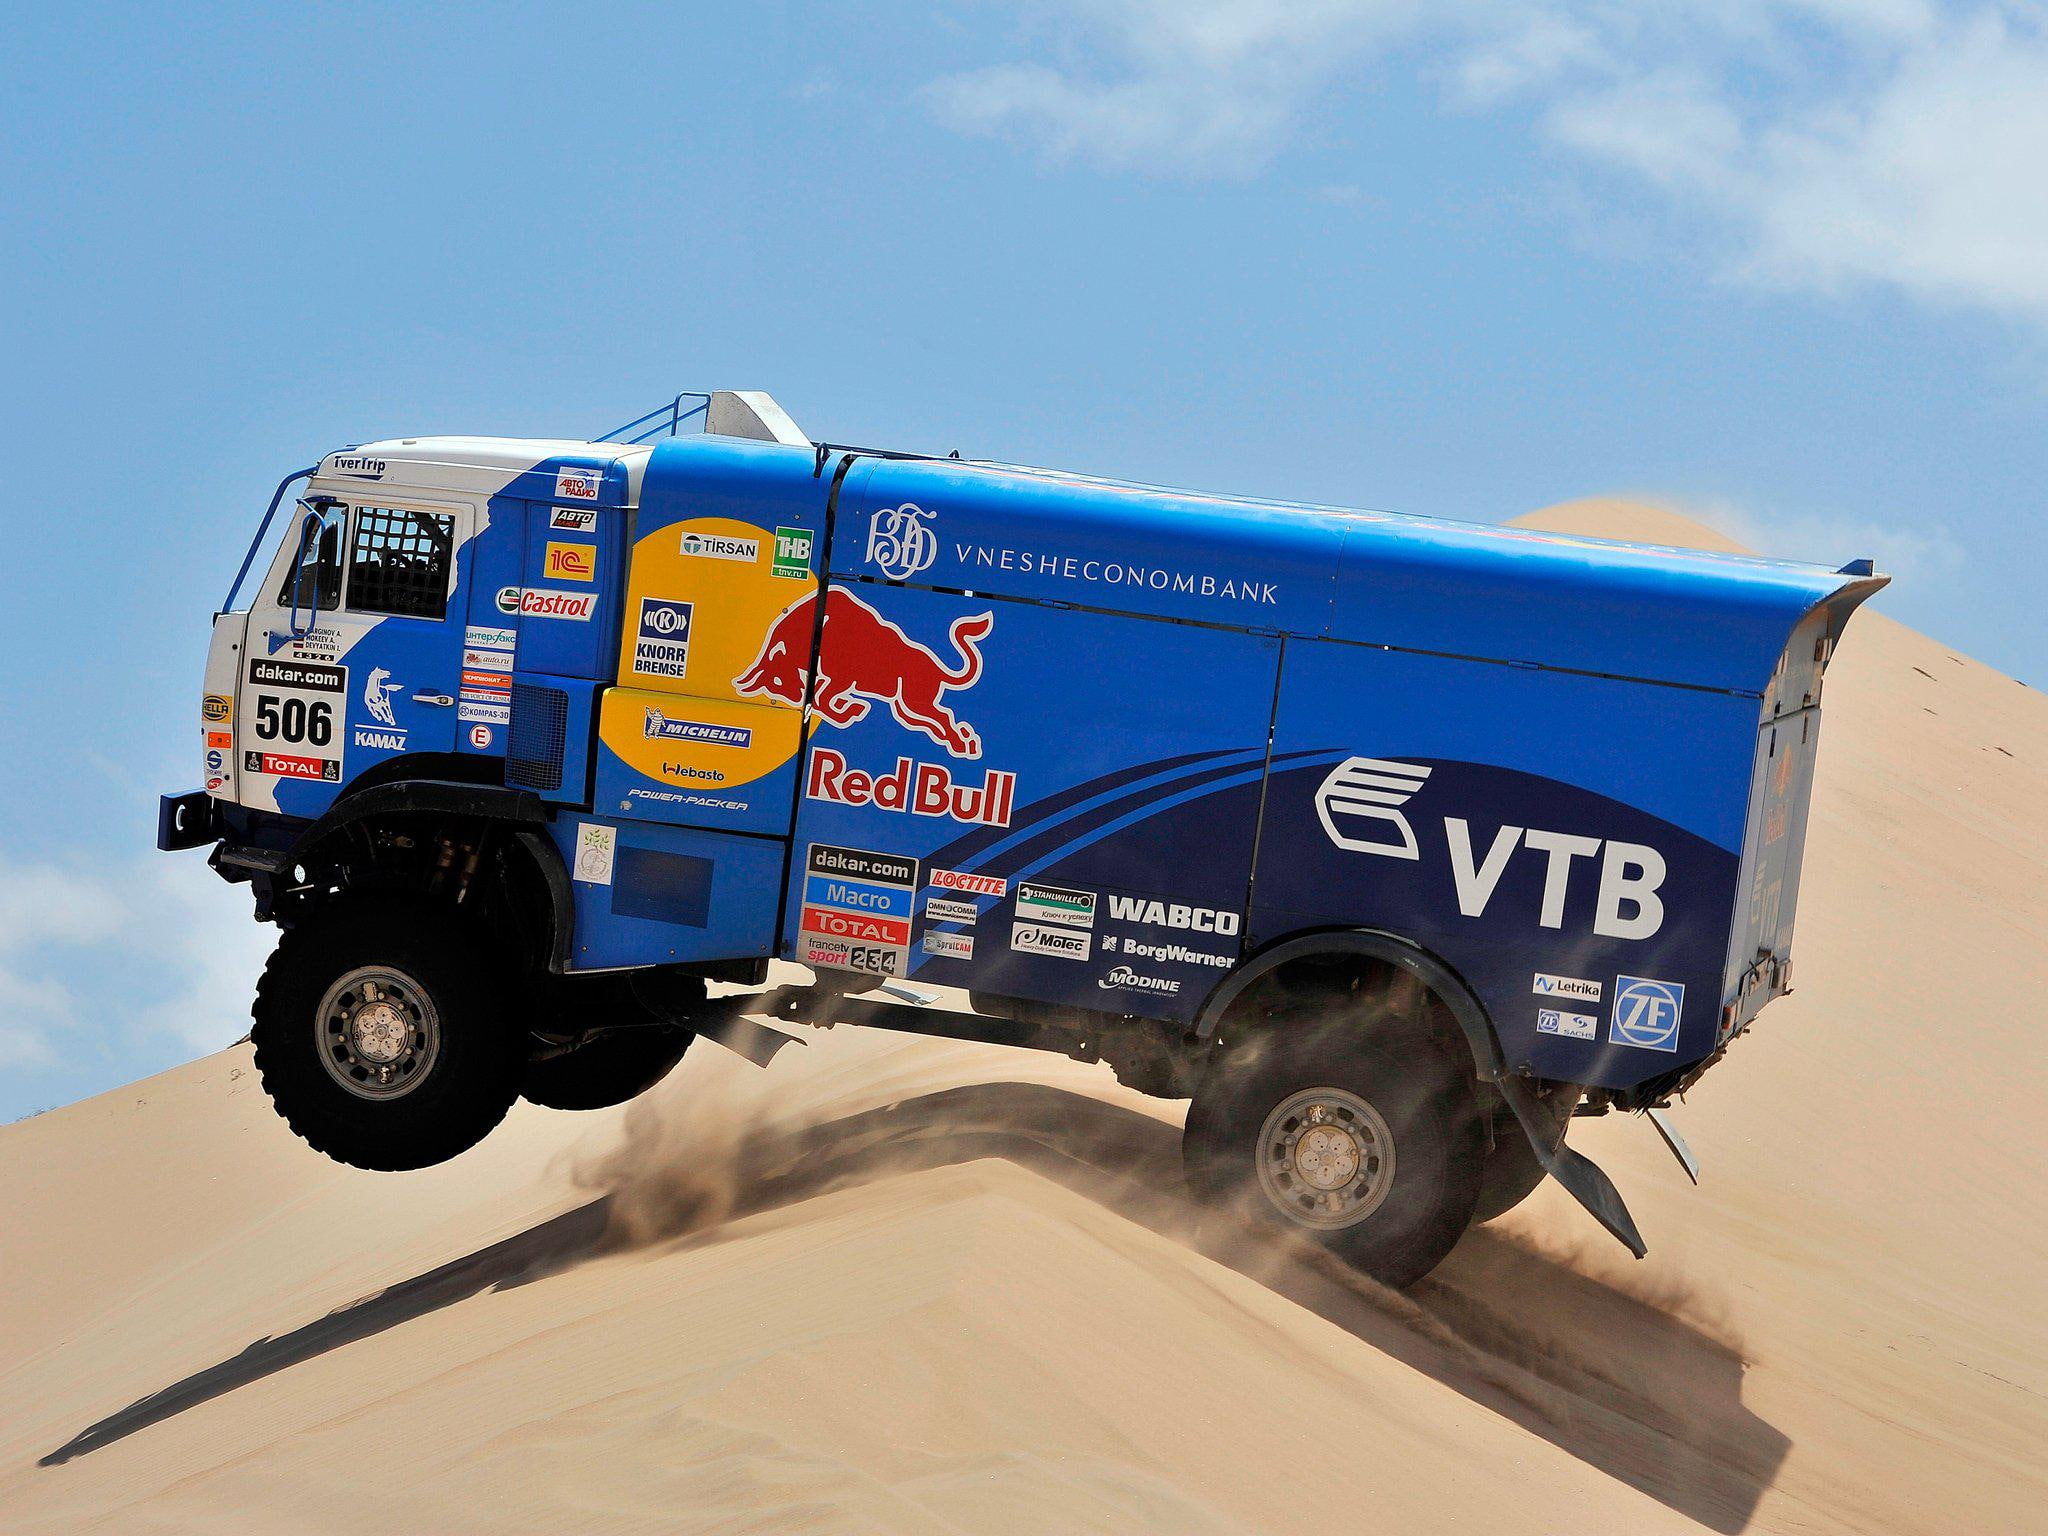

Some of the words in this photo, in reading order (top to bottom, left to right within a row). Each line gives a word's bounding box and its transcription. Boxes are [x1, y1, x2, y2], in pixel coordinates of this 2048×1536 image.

[334, 456, 386, 474] TverTrip
[778, 568, 802, 578] tnv.ru
[955, 543, 1279, 606] VNESHECONOMBANK
[520, 591, 590, 617] Castrol
[482, 656, 510, 665] auto.ru
[636, 643, 686, 662] KNORR
[255, 664, 339, 686] dakar.com
[634, 659, 684, 677] BREMSE
[255, 694, 333, 748] 506
[469, 708, 509, 719] KOMPAS-3D
[354, 731, 407, 751] KAMAZ
[474, 729, 486, 745] E
[665, 723, 748, 742] MICHELIN
[264, 756, 320, 775] TOTAL
[662, 762, 725, 781] Webasto
[807, 748, 912, 811] Red
[913, 763, 1015, 827] Bull
[628, 788, 749, 811] POWER-PACKER
[815, 851, 909, 879] dakar.com
[931, 870, 1005, 895] LOCTITE
[1443, 816, 1667, 941] VTB
[826, 883, 891, 910] Macro
[1108, 894, 1240, 936] WABCO
[815, 912, 896, 942] TOTAL
[808, 938, 850, 953] francetv
[1123, 938, 1236, 968] BorgWarner
[808, 950, 848, 966] sport
[1108, 971, 1181, 992] MODINE
[1557, 980, 1600, 996] Letrika
[1623, 992, 1674, 1035] ZF
[1563, 1029, 1594, 1039] SACHS
